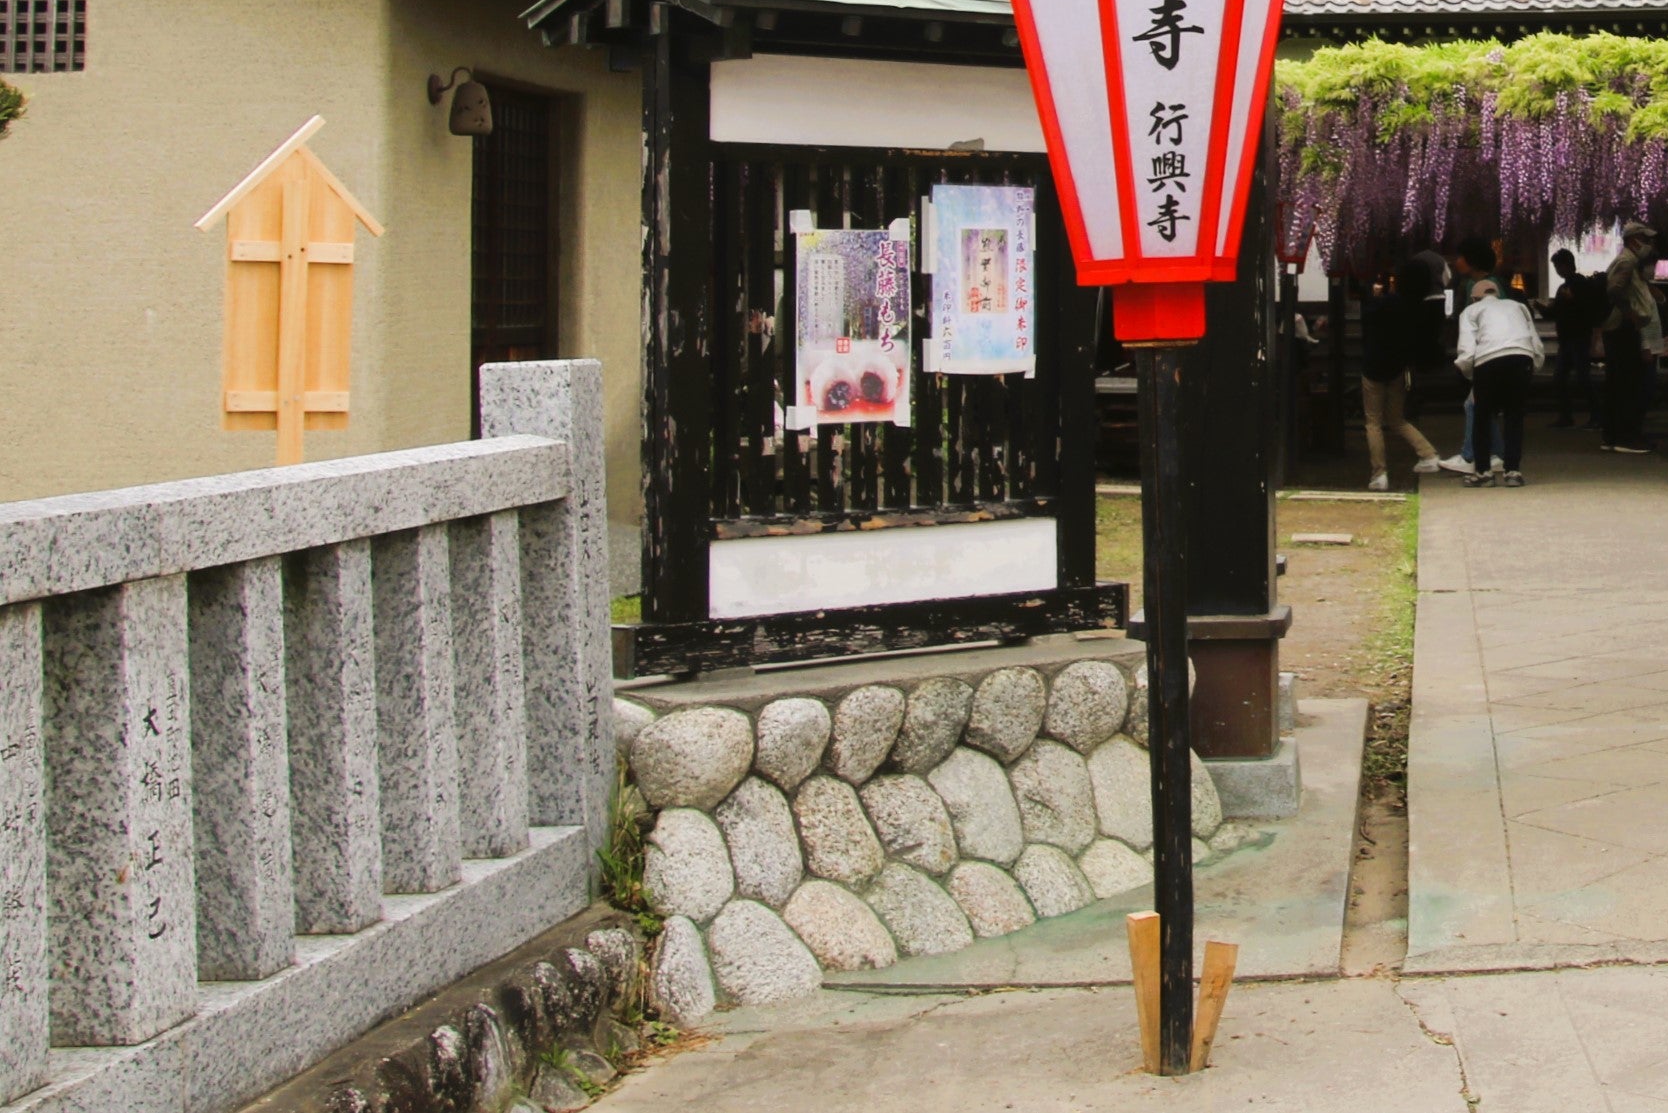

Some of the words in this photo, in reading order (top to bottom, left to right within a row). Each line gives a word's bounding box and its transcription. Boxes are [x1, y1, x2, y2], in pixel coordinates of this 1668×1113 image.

[1146, 101, 1190, 242] 行興寺
[876, 241, 897, 353] 長藤もち
